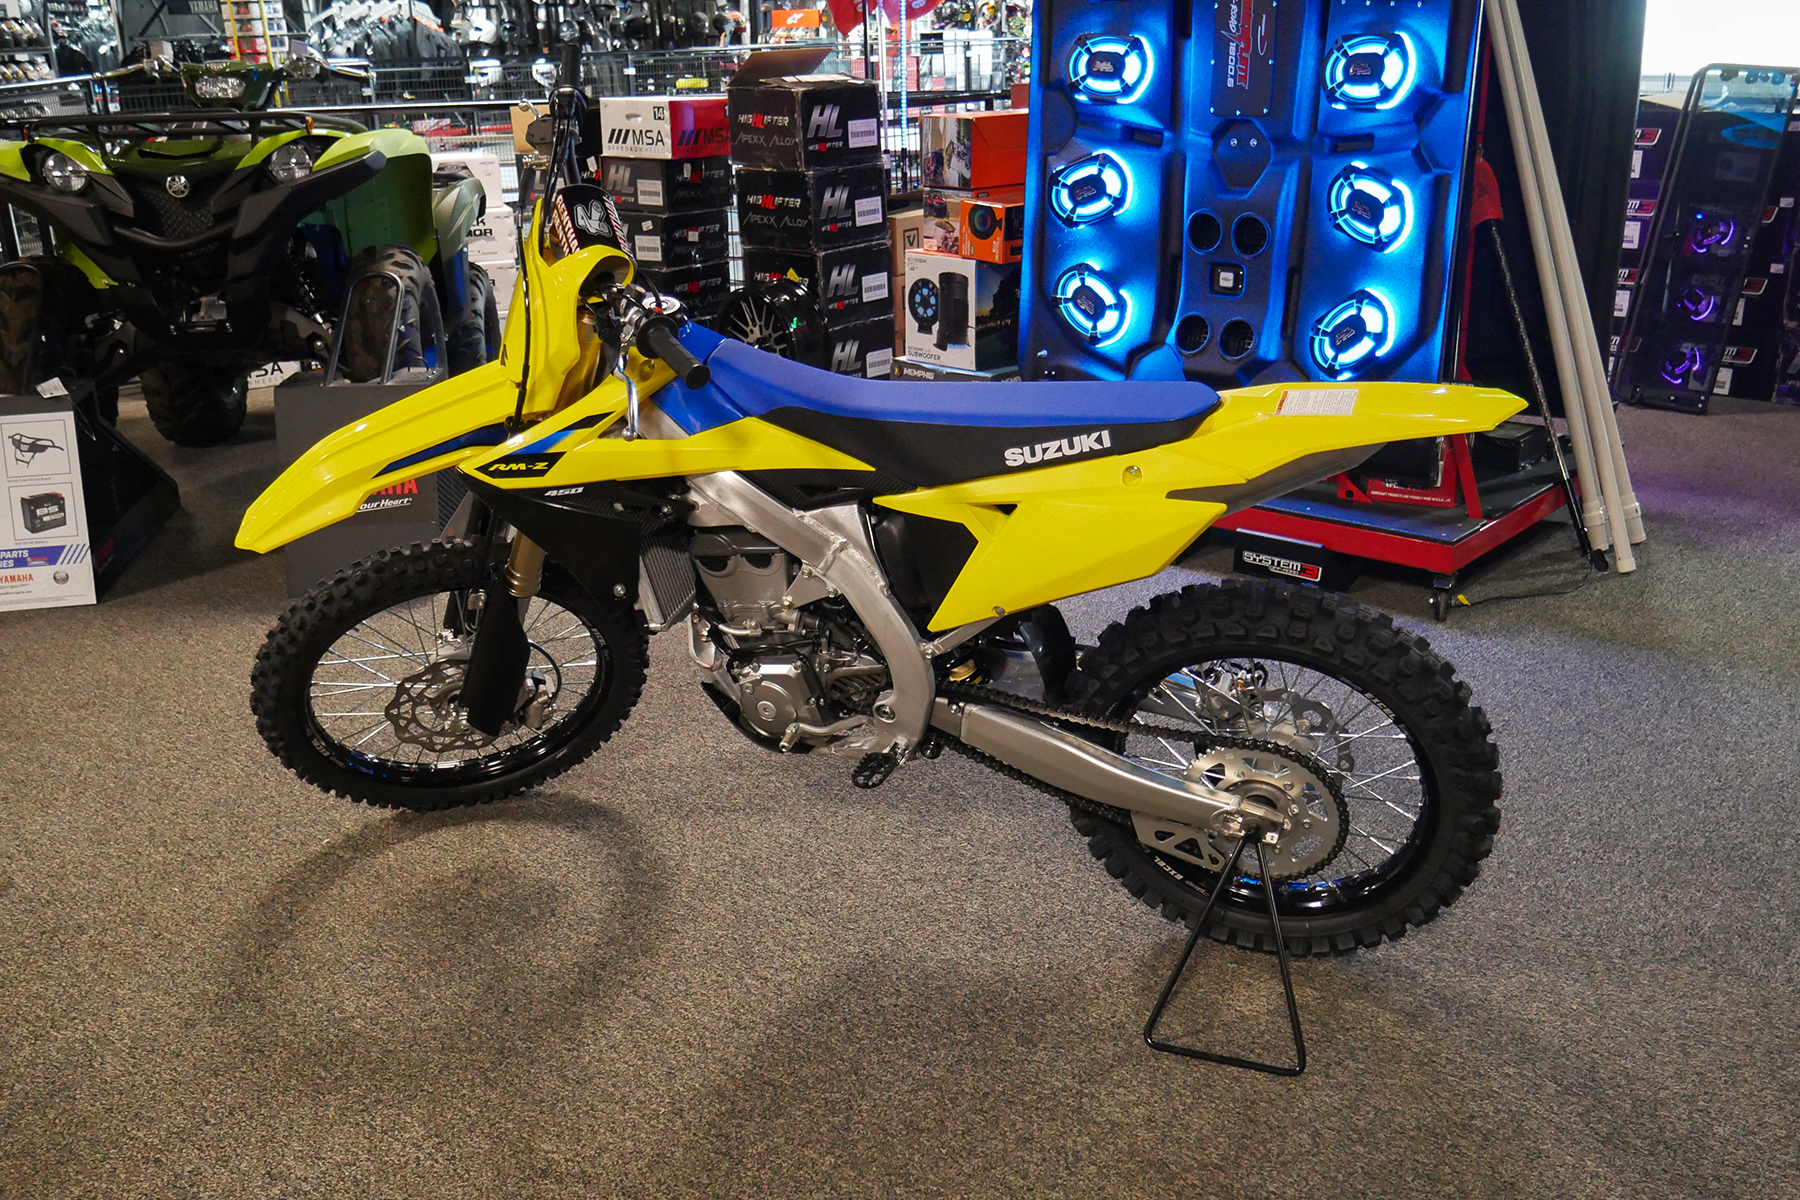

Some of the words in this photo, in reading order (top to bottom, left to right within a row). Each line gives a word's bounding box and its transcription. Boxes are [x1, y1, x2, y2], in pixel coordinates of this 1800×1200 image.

[189, 0, 219, 14] YAMAHA
[653, 107, 665, 120] 14
[807, 104, 842, 139] HL
[606, 164, 635, 194] HL
[820, 185, 853, 219] HL
[827, 263, 858, 298] HL
[831, 339, 862, 374] HL
[907, 350, 941, 360] SUBWOOFER
[903, 368, 935, 380] MEMPHIS
[1004, 430, 1111, 467] SUZUKI
[488, 462, 549, 471] RM-Z
[544, 487, 585, 497] 450
[0, 549, 29, 560] PARTS
[1243, 551, 1301, 572] SYSTEM
[0, 573, 34, 584] YAMAHA
[1365, 692, 1396, 721] EXCEL
[1153, 855, 1184, 880] EXCEL
